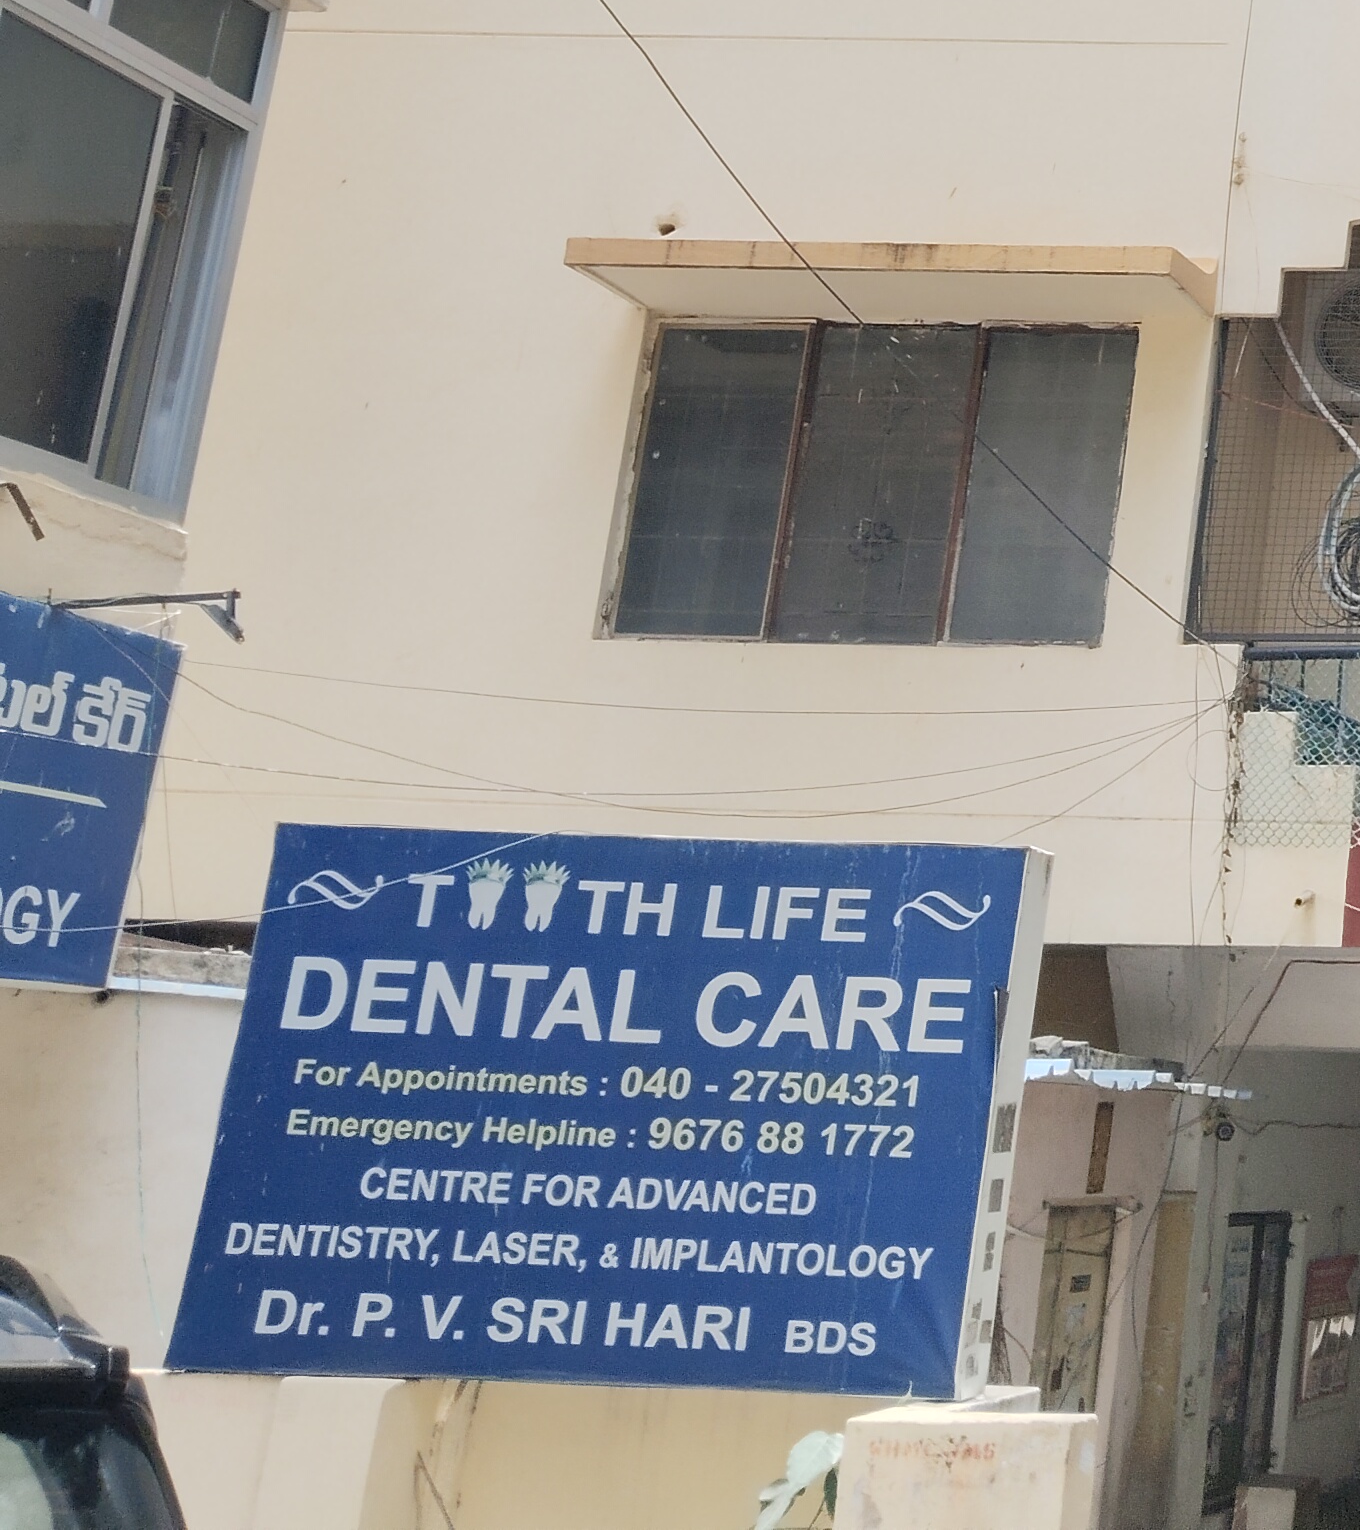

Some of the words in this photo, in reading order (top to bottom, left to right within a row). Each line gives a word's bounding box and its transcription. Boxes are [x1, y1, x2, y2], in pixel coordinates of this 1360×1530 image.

[0, 885, 81, 947] GY
[702, 885, 871, 943] LIFE
[280, 956, 661, 1044] DENTAL
[695, 971, 972, 1054] CARE
[294, 1059, 351, 1086] For
[356, 1061, 588, 1097] Appointments
[620, 1066, 692, 1100] 040
[729, 1069, 920, 1107] 27504321
[286, 1109, 474, 1149] Emergency
[482, 1116, 617, 1152] Helpline
[648, 1117, 745, 1153] 9676
[756, 1120, 805, 1155] 88
[821, 1123, 915, 1158] 1772
[360, 1166, 513, 1204] CENTRE
[521, 1173, 601, 1208] FOR
[607, 1177, 817, 1216] ADVANCED
[224, 1222, 440, 1268] DENTISTRY,
[452, 1230, 587, 1273] LASER,
[599, 1243, 619, 1269] &
[630, 1237, 934, 1280] IMPLANTOLOGY
[254, 1289, 329, 1336] Dr.
[352, 1292, 396, 1338] P.
[422, 1294, 464, 1340] V.
[486, 1297, 588, 1345] SRI
[604, 1301, 751, 1351] HARI
[784, 1320, 877, 1357] BDS
